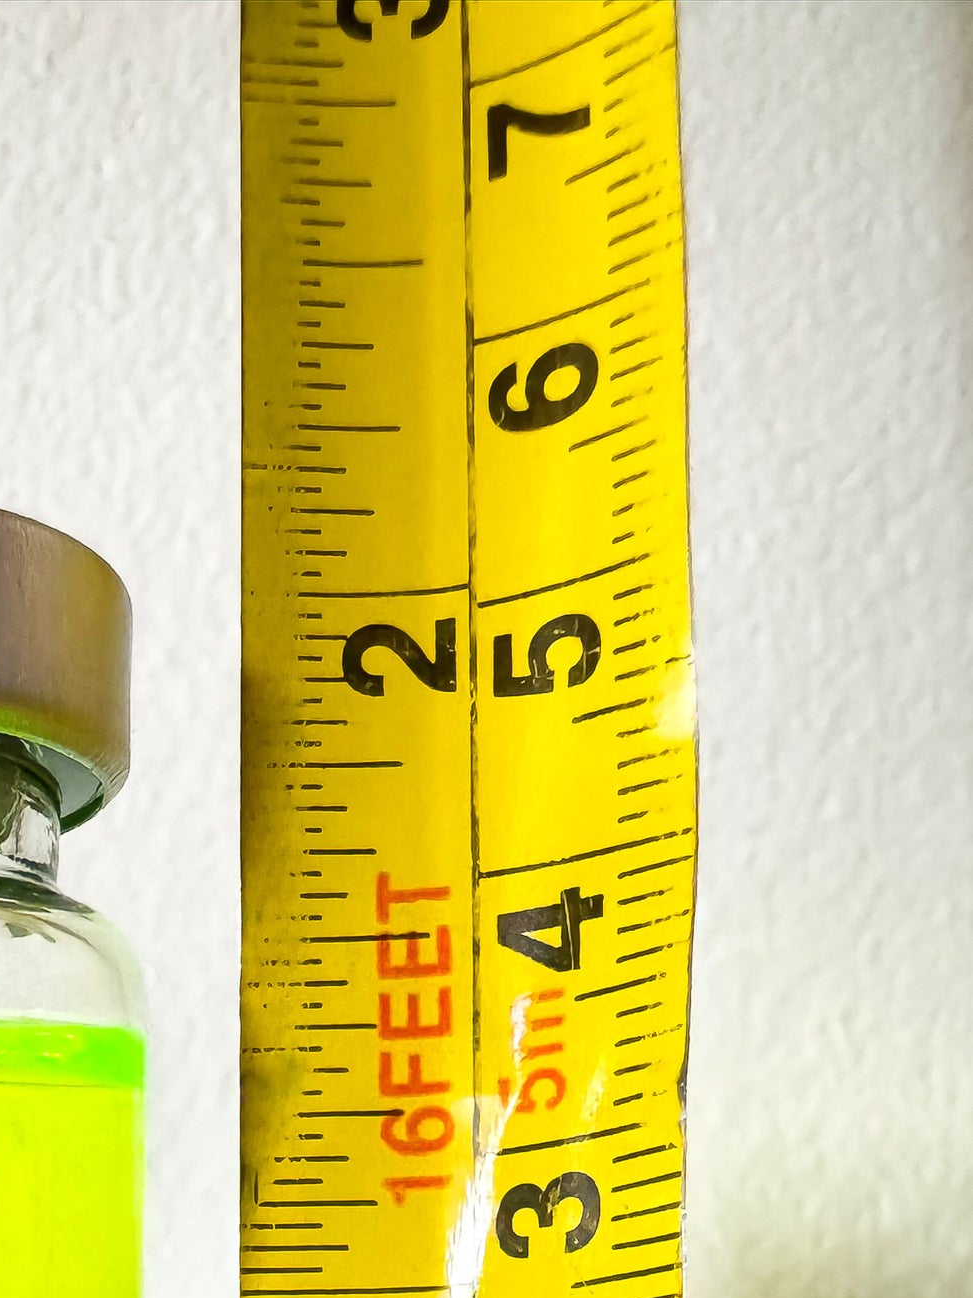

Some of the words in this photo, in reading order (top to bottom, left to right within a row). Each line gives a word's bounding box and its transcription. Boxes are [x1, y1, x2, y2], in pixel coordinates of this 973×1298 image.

[487, 103, 591, 182] 7
[488, 343, 599, 432] 6
[341, 617, 457, 697] 2
[493, 613, 602, 697] 5
[497, 887, 604, 971] 4
[499, 987, 567, 1113] 5m
[497, 1171, 602, 1259] 3
